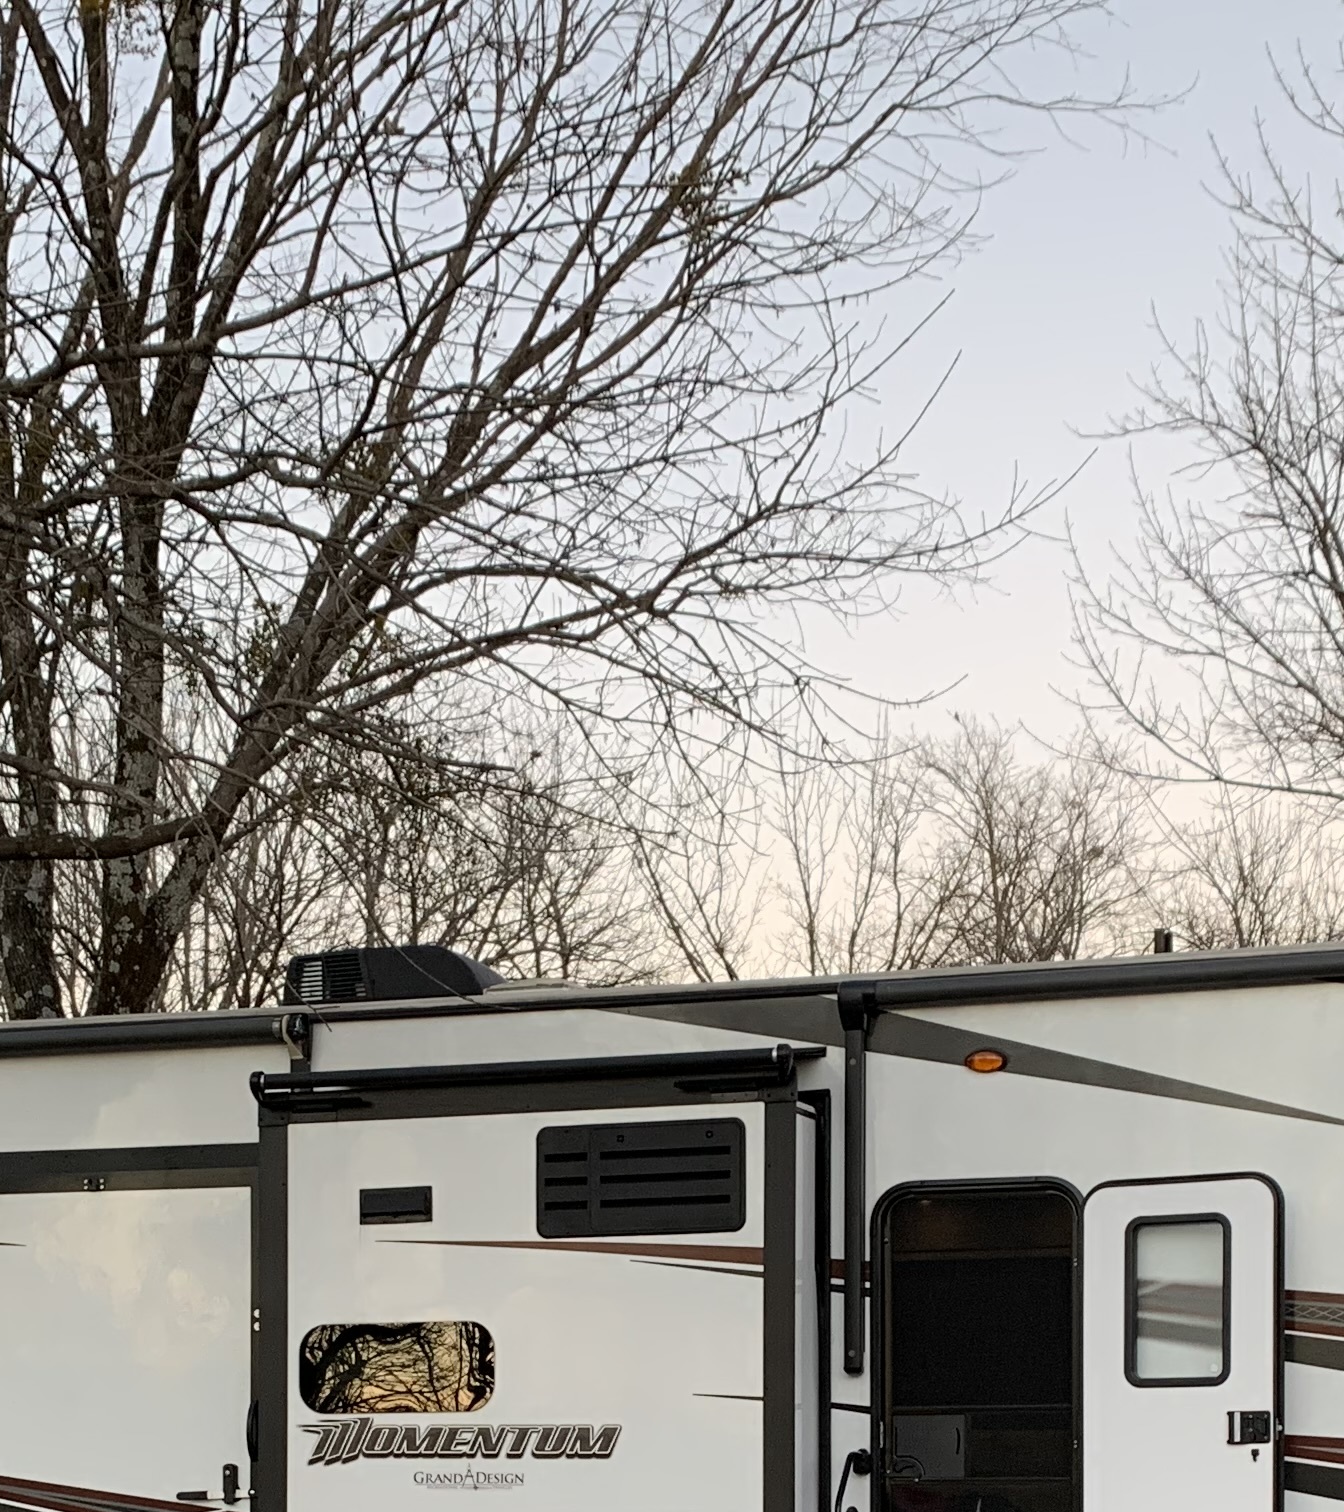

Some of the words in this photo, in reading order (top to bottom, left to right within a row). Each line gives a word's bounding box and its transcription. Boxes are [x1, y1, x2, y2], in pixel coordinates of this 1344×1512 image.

[297, 1417, 622, 1466] MOMENTUM
[413, 1471, 463, 1484] GRAND
[476, 1471, 524, 1484] DESIGN
